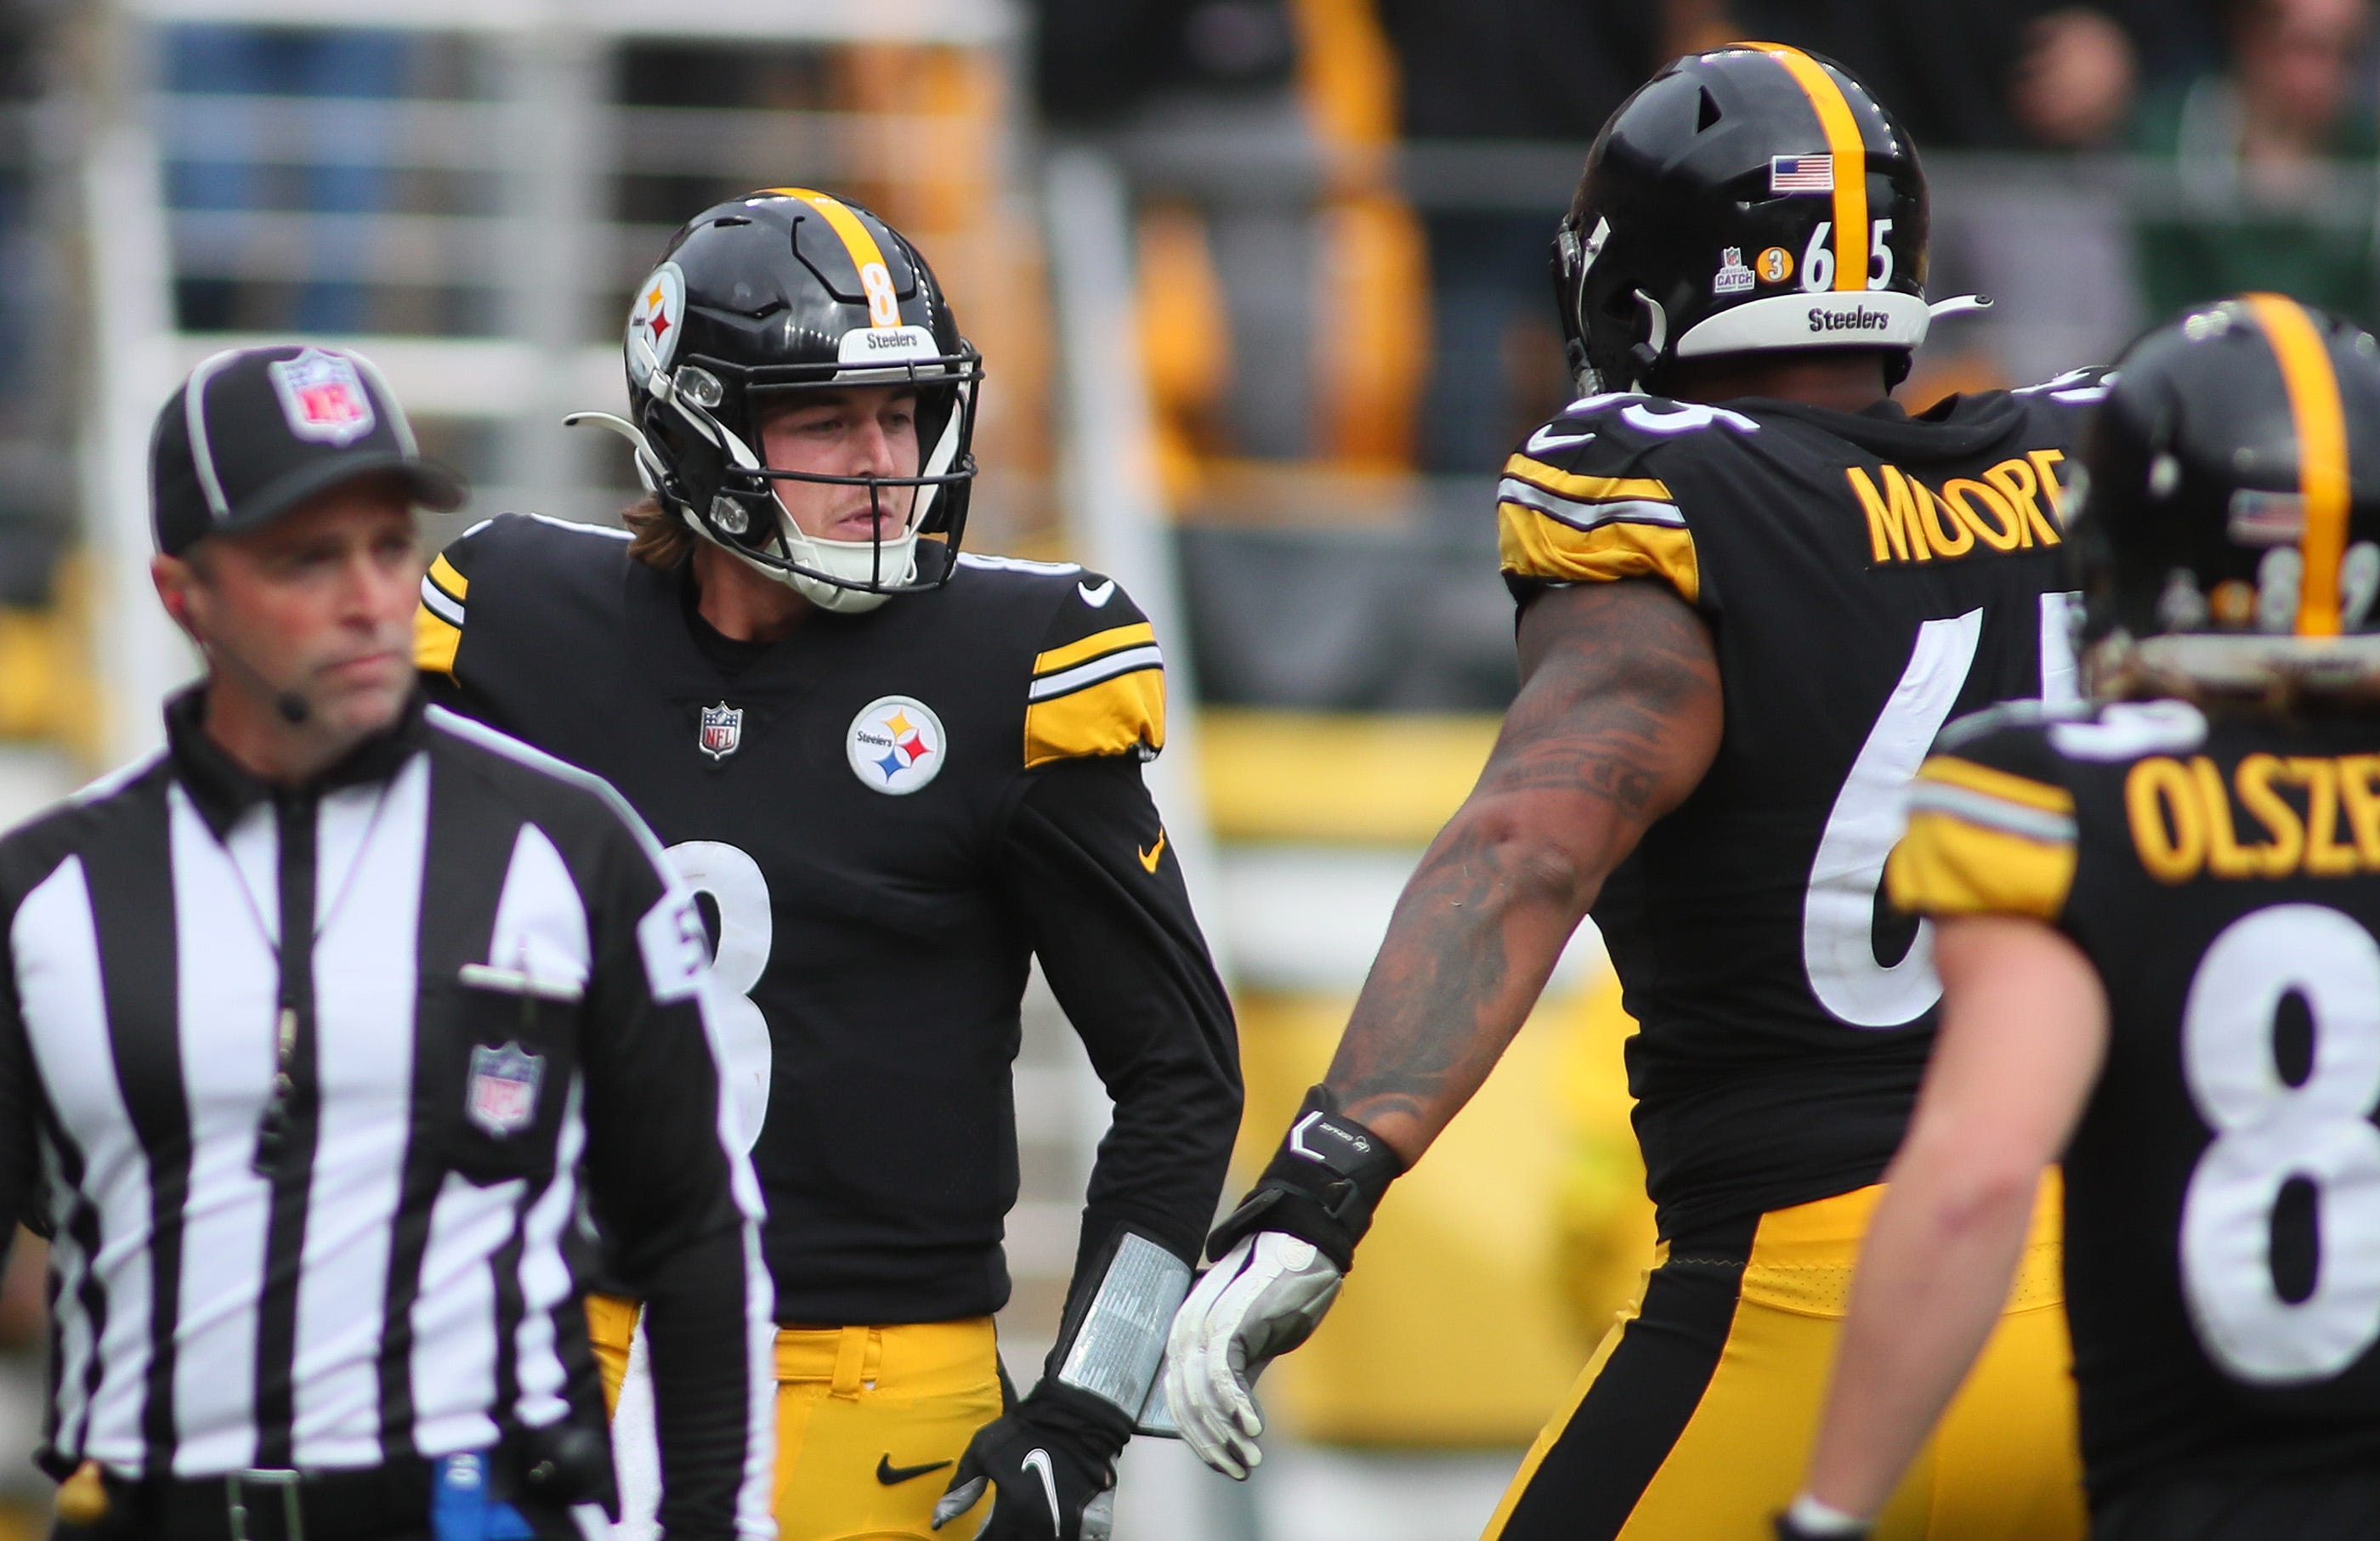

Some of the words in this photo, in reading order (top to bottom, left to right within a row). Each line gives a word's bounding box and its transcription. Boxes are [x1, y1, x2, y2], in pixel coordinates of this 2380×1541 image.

[1768, 249, 1783, 280] 3
[1718, 272, 1754, 286] CATCH
[862, 262, 898, 326] 8
[1808, 304, 1890, 332] Steelers
[867, 329, 918, 349] Steelers
[705, 726, 733, 748] NFL
[856, 730, 893, 748] Steelers
[2180, 903, 2380, 1385] 8
